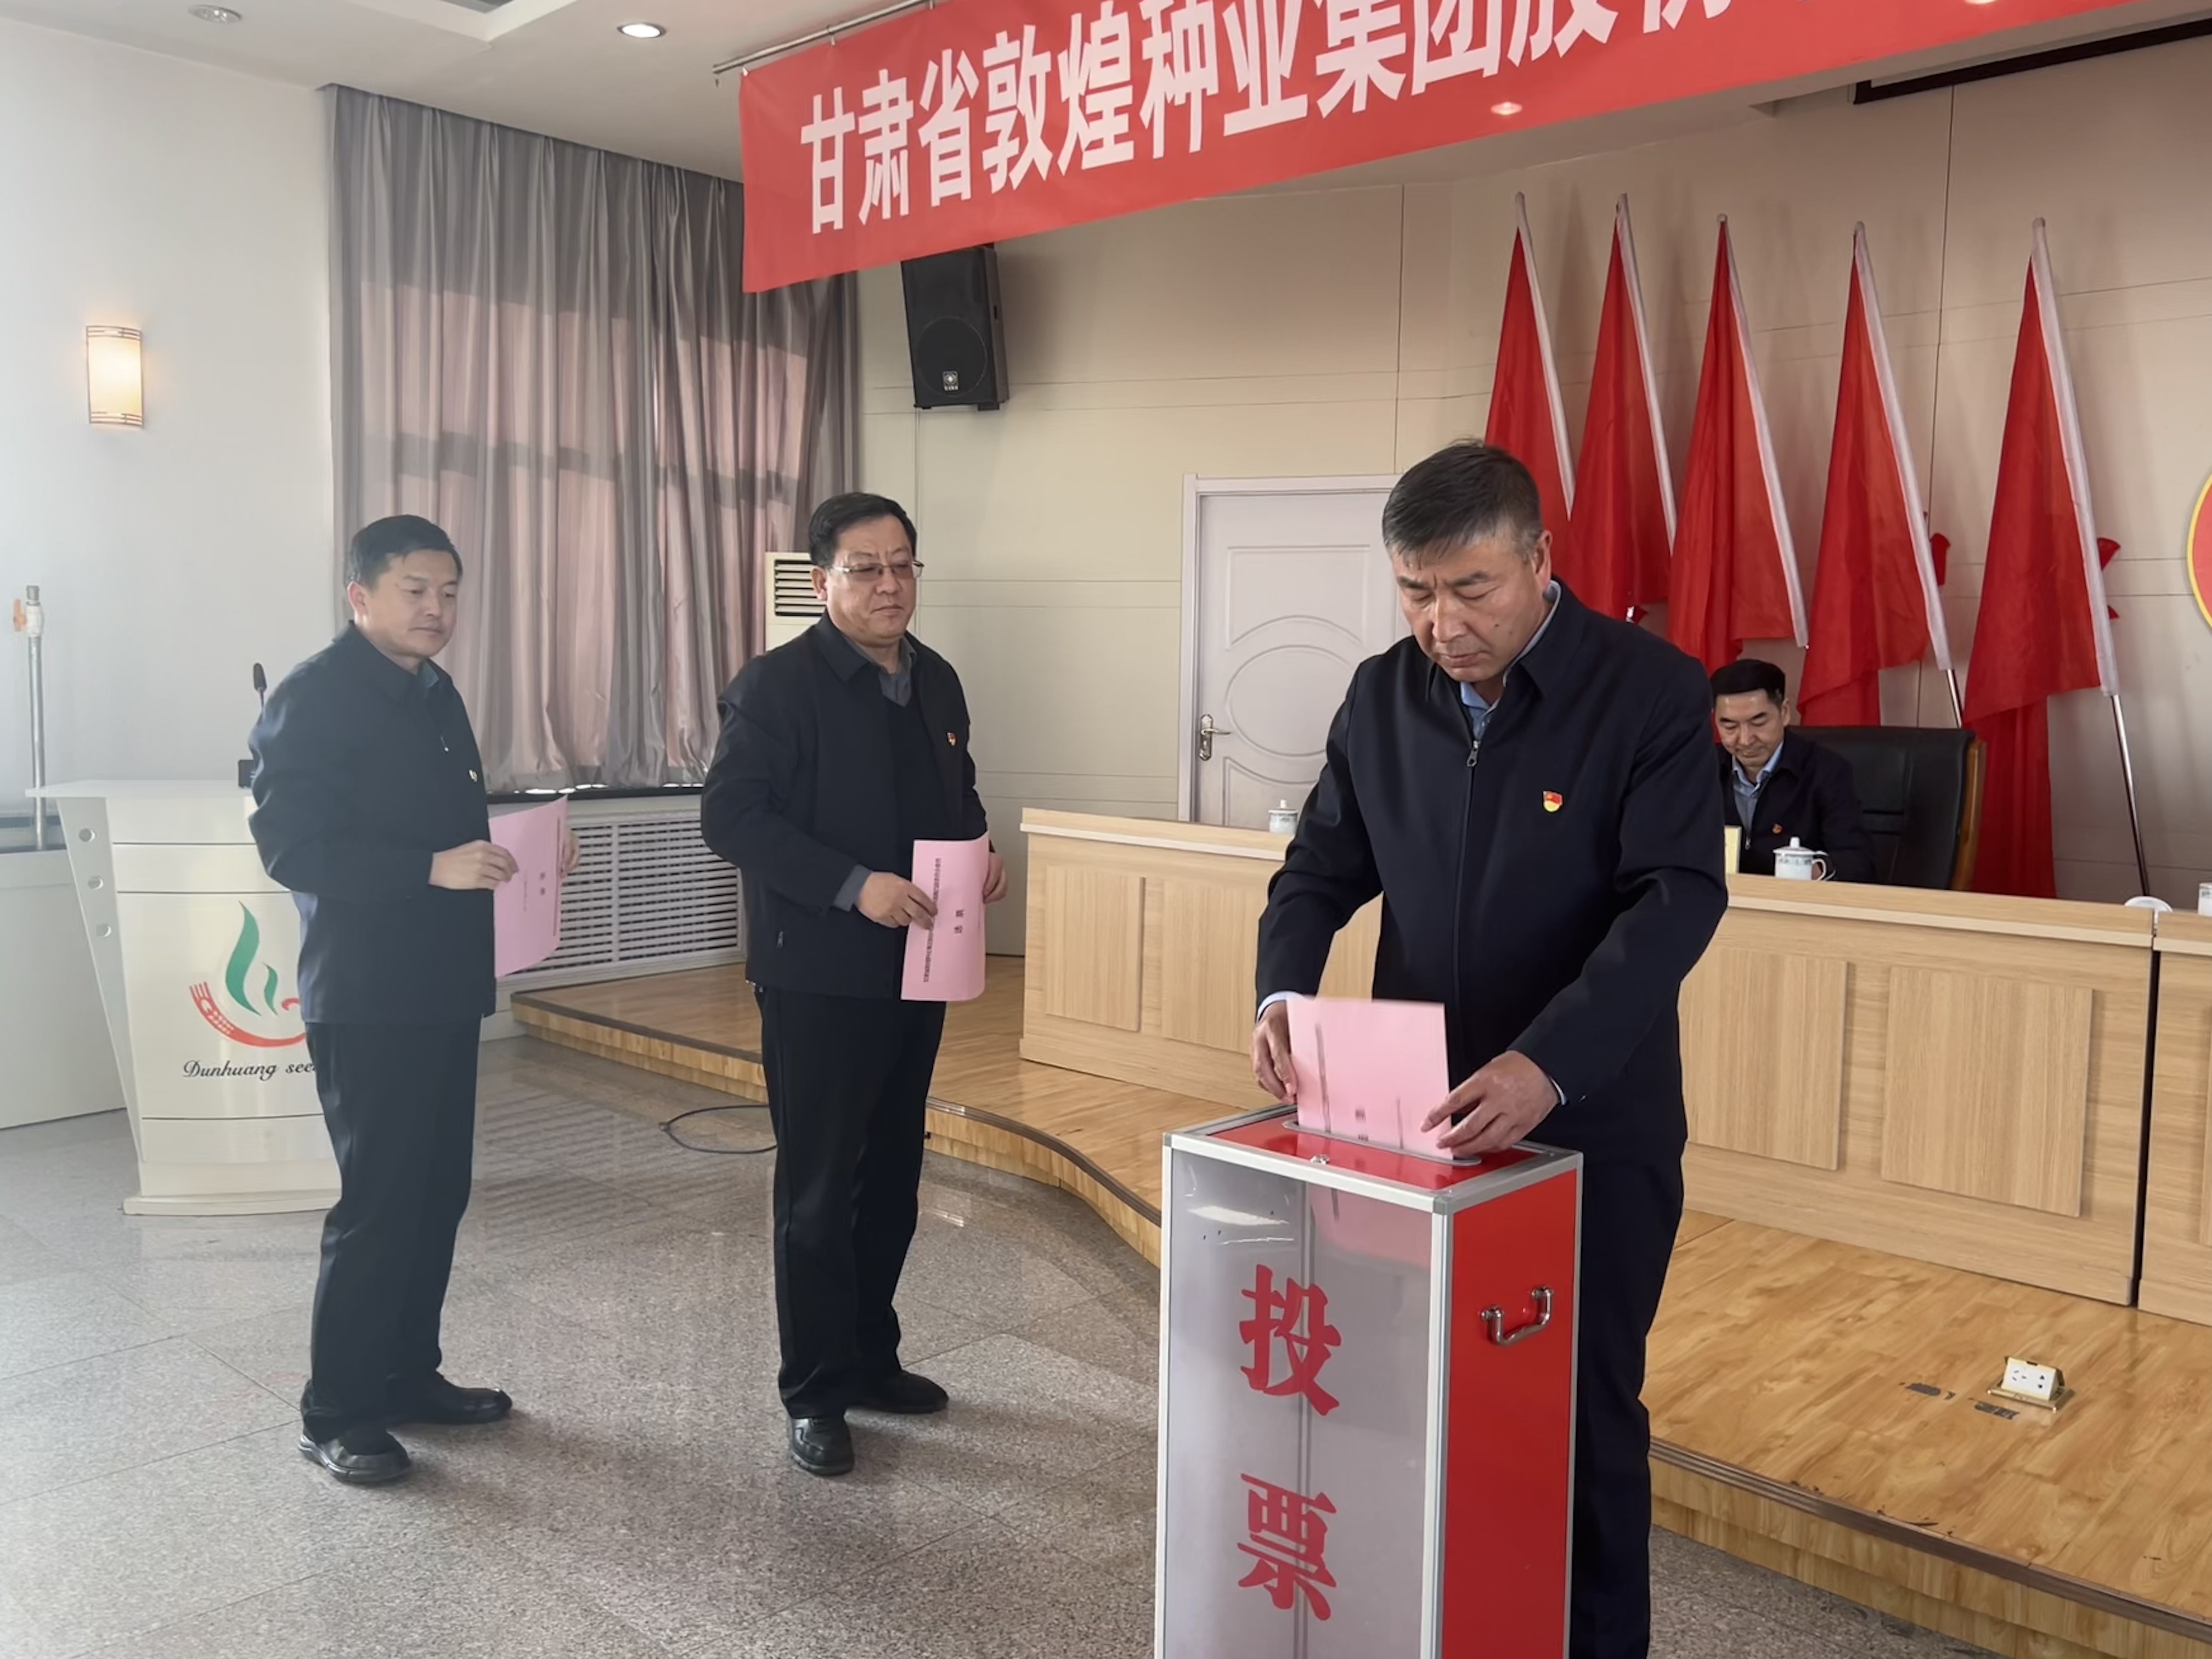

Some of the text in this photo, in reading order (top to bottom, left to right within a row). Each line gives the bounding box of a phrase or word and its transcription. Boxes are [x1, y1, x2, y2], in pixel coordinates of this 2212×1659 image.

[183, 1060, 315, 1081] Dunhuang see
[1237, 1263, 1342, 1621] 投票
